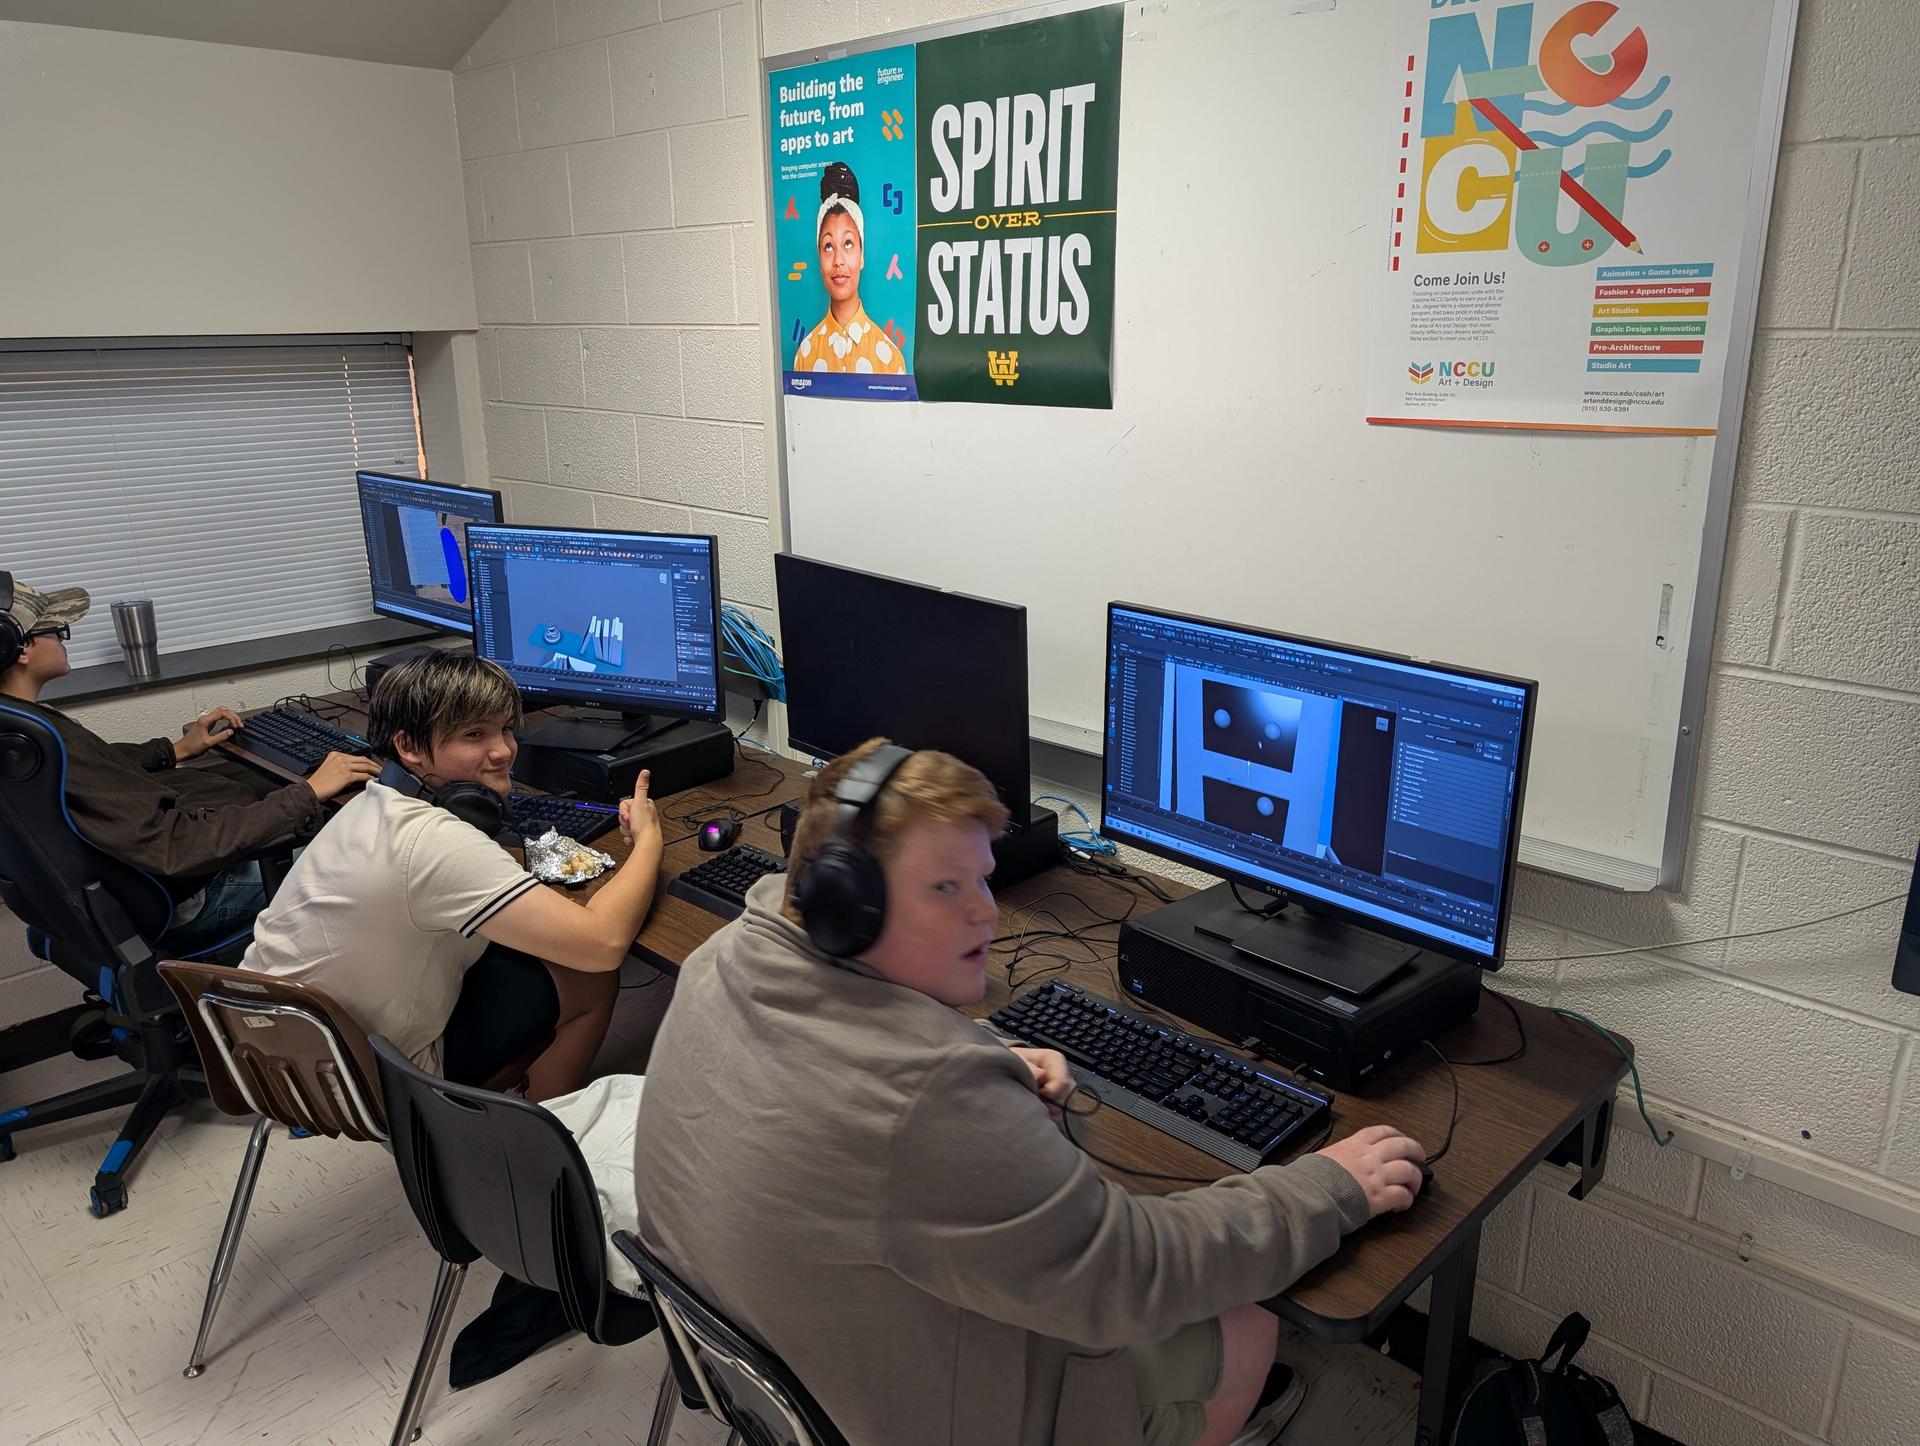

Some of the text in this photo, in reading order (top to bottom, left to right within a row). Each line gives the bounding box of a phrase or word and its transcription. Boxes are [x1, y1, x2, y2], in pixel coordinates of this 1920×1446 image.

[877, 67, 897, 77] future
[877, 72, 904, 85] engineer
[780, 73, 864, 104] Building the
[780, 101, 864, 128] future, from
[780, 126, 854, 155] apps to art
[930, 82, 1096, 213] SPIRIT
[974, 211, 1042, 230] OVER
[1601, 269, 1640, 278] Animation
[1648, 268, 1670, 276] Game
[1671, 267, 1700, 277] Design
[927, 233, 1091, 336] STATUS
[1414, 271, 1506, 287] Come Join Us!
[1599, 288, 1629, 296] Fashion
[1635, 287, 1666, 296] Apparel
[1667, 286, 1695, 295] Design
[1610, 306, 1639, 314] Studies
[1595, 325, 1625, 334] Graphic
[1625, 325, 1652, 334] Design
[1660, 324, 1701, 333] Innovation
[1593, 343, 1661, 351] Pre-Architecture
[1438, 361, 1495, 377] NCCU
[1591, 361, 1617, 369] Studio
[791, 378, 812, 388] amazon
[1438, 378, 1452, 387] Art
[1463, 378, 1494, 389] Design
[1582, 398, 1665, 406] artanddesign@nccu.edu
[1266, 885, 1288, 897] OMEN
